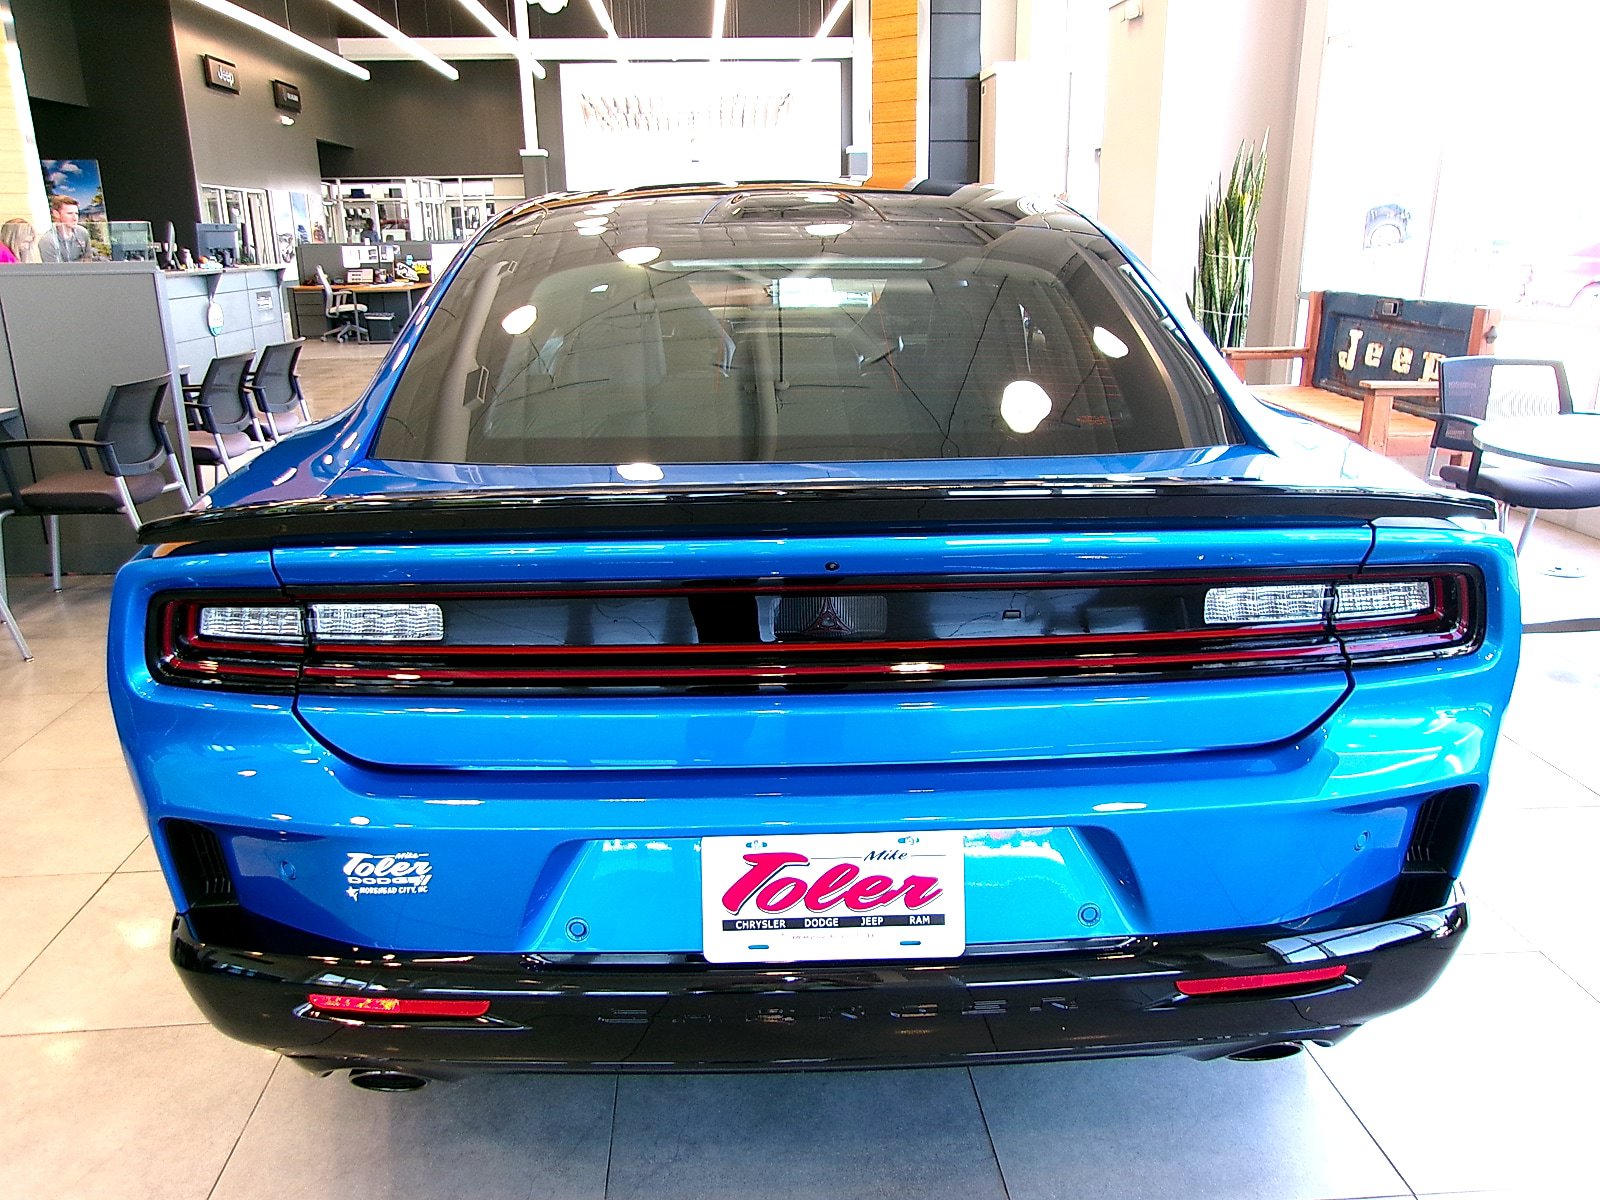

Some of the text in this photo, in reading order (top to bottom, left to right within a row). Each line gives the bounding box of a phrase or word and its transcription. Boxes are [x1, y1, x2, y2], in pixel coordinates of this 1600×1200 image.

[217, 65, 235, 87] Jeep
[343, 852, 433, 877] Toler
[864, 849, 909, 862] Mike
[359, 886, 398, 895] MOREHEAD
[417, 885, 429, 894] NC
[722, 852, 943, 915] Toler
[735, 915, 931, 930] CHRYSLER DODGE JEEP RAM
